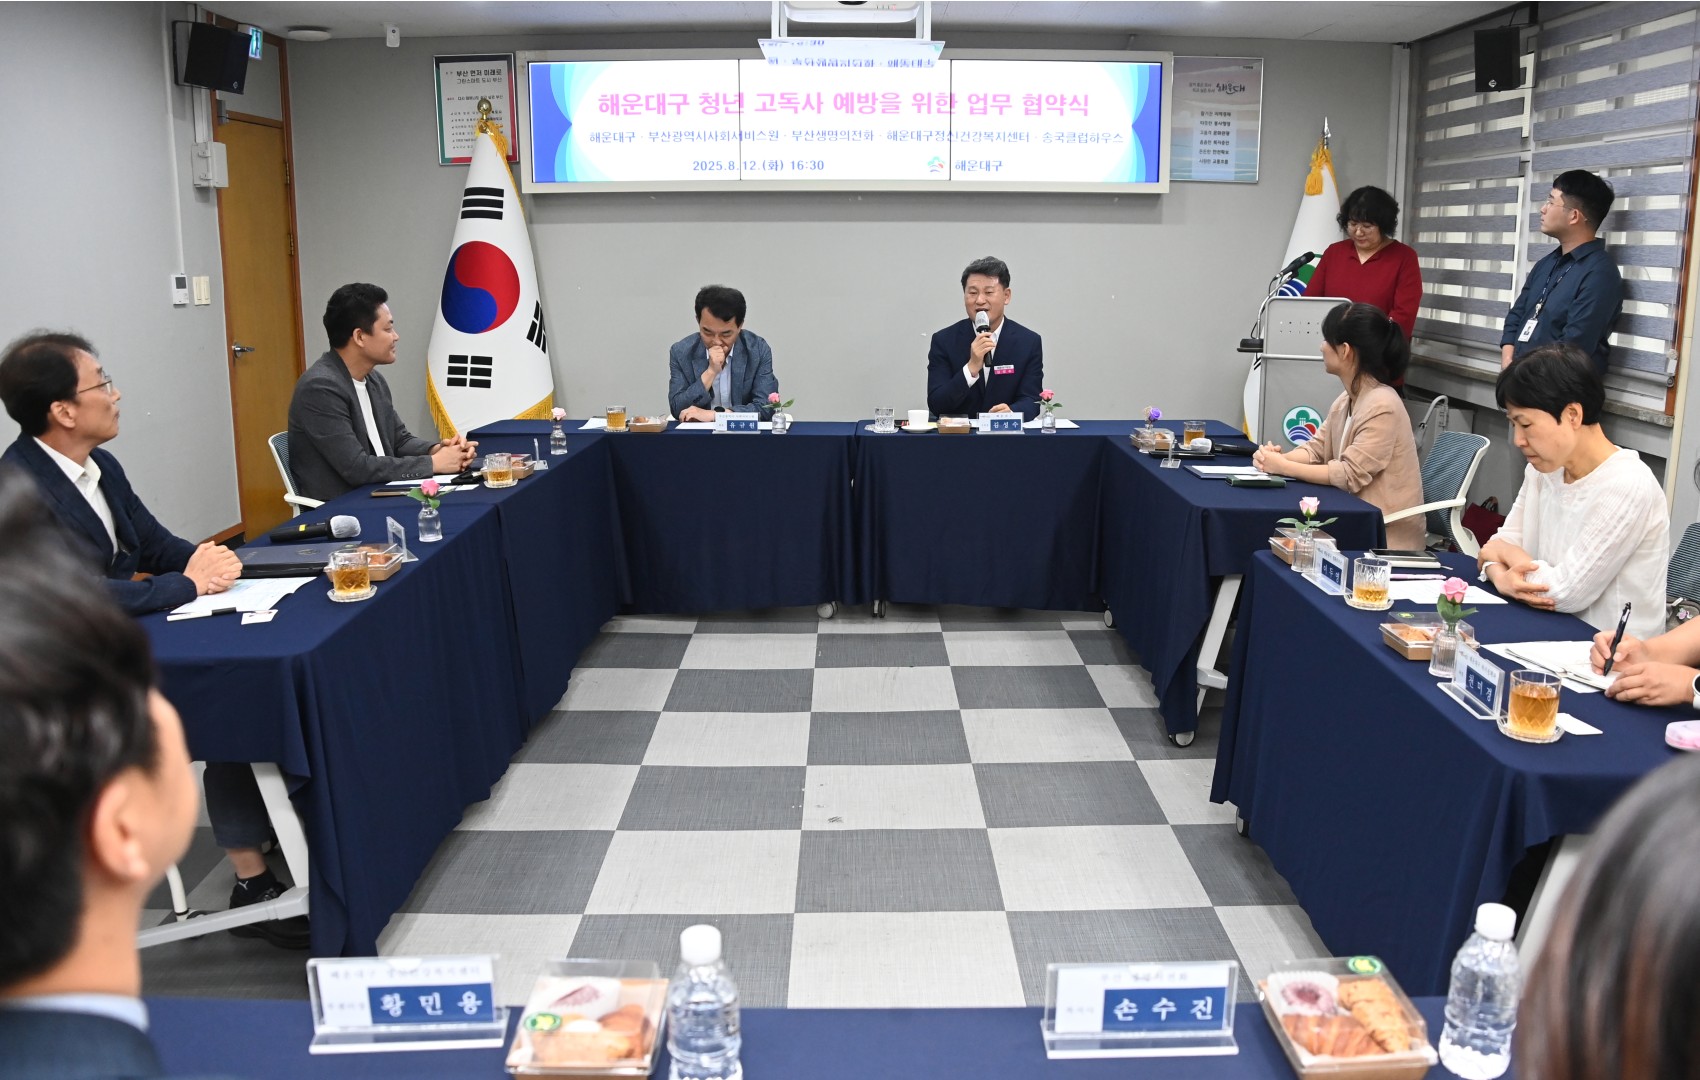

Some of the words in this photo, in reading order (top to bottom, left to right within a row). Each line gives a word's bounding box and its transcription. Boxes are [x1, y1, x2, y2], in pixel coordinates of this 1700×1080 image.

[598, 93, 690, 116] 해운대구
[699, 92, 745, 116] 청년
[754, 92, 824, 115] 고독사
[833, 91, 902, 115] 예방을
[911, 92, 957, 115] 위한
[967, 92, 1013, 116] 업무
[1022, 93, 1089, 117] 협약식
[589, 131, 636, 143] 해운대구
[648, 129, 779, 143] 부산광역시사회서비스원
[791, 129, 874, 142] 부산생명의전화
[887, 130, 1030, 143] 해운대구정신건강복지센터
[1042, 131, 1124, 144] 송국클럽하우스
[791, 160, 824, 171] 16:30
[955, 160, 1003, 172] 해운대구
[380, 991, 483, 1017] 황민용
[1113, 996, 1213, 1021] 손수진
